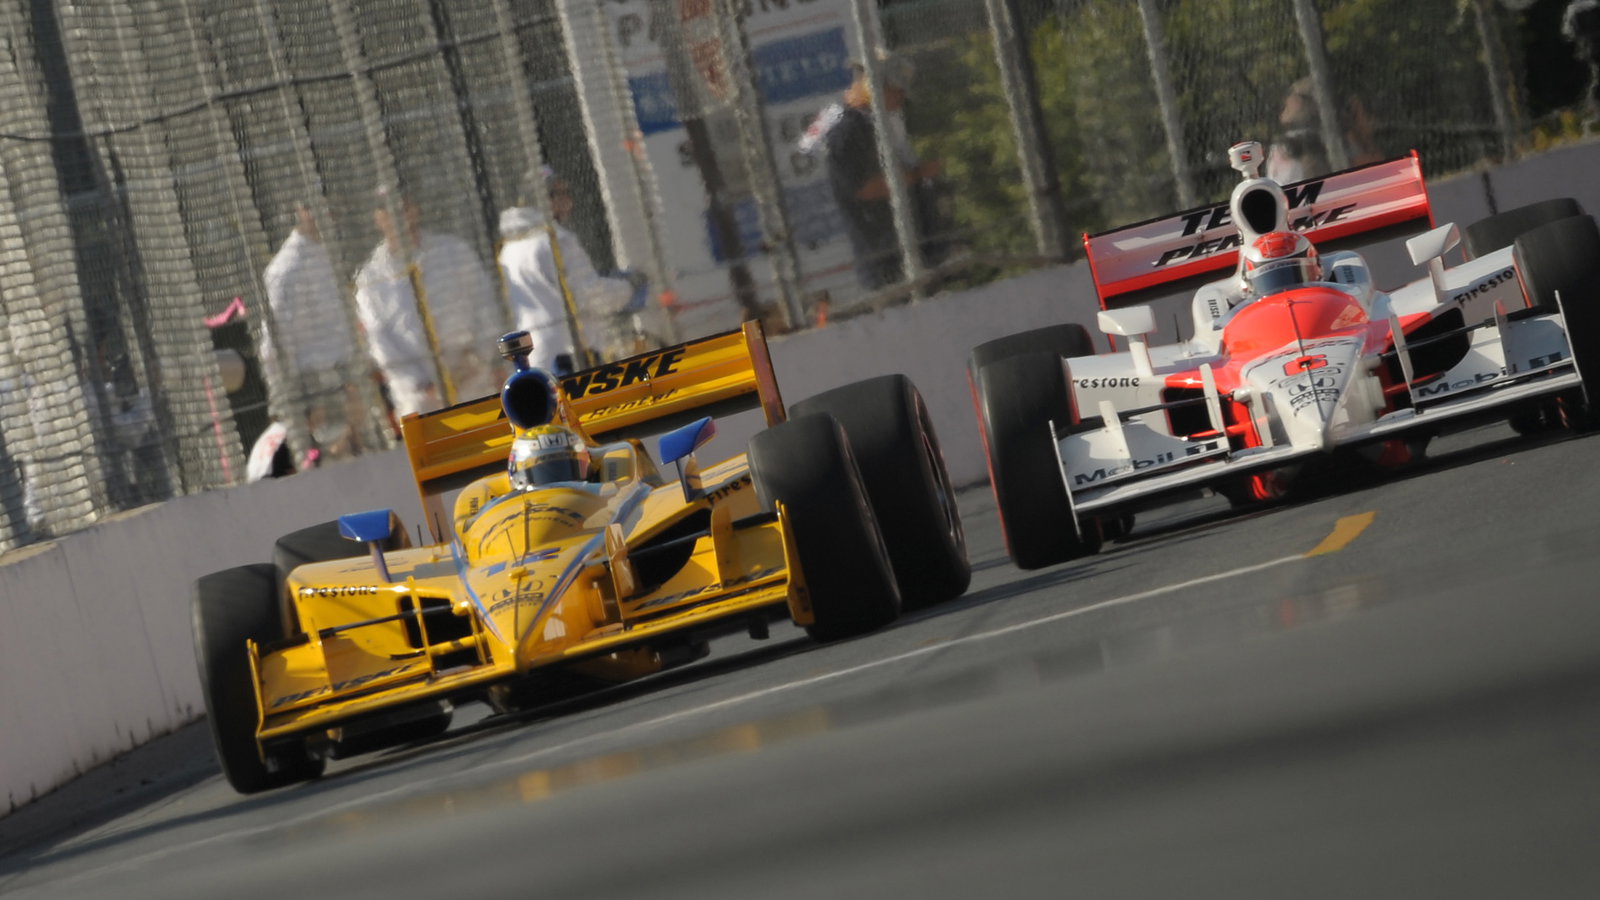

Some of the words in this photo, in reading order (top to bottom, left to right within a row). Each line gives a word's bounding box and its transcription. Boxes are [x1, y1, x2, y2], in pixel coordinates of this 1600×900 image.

[1180, 181, 1324, 237] TEM
[1152, 203, 1358, 267] PENKE
[1454, 266, 1515, 307] Firesto
[1418, 363, 1517, 397] Mobil
[1074, 452, 1173, 485] Mobil
[299, 585, 378, 602] Firestone
